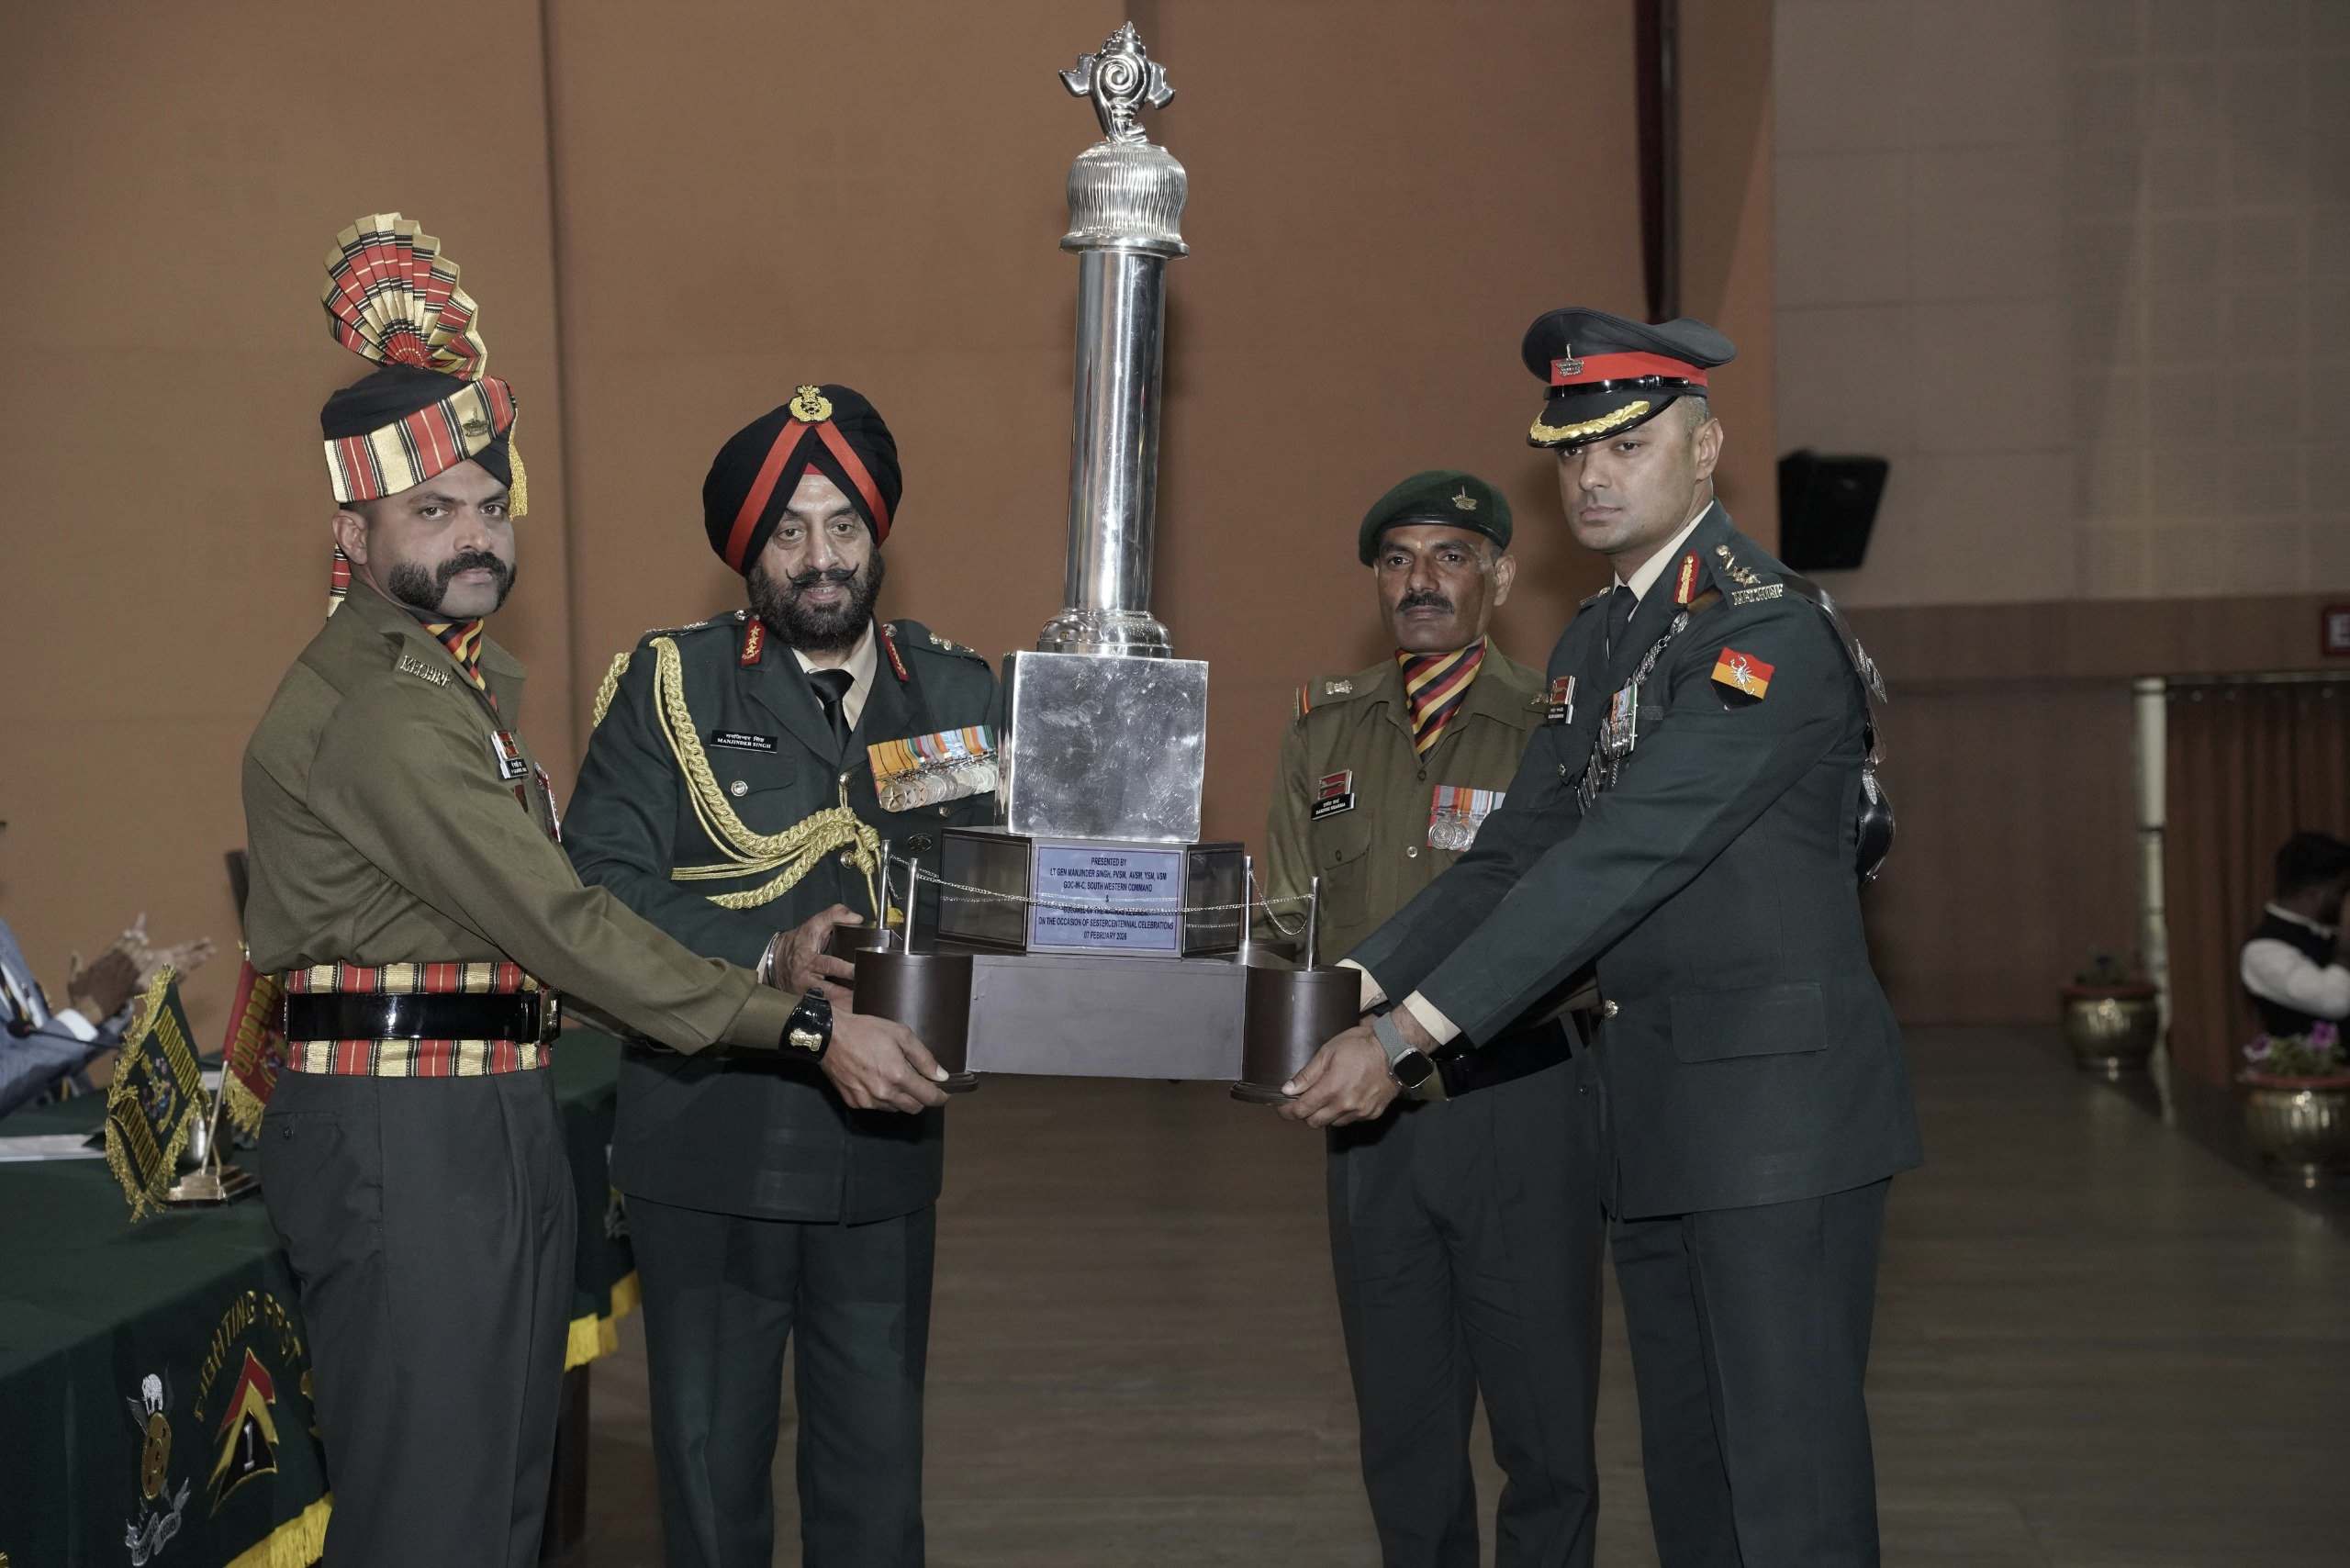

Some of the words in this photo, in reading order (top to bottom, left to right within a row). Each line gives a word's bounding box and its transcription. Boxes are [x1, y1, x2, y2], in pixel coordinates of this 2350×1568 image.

[717, 737, 752, 746] MANJINDER
[1091, 857, 1120, 867] PRESENTED
[1120, 858, 1127, 867] BY
[1050, 868, 1057, 876] LT
[1057, 868, 1068, 877] GEN
[1068, 868, 1095, 878] MANJINDER
[1157, 872, 1168, 880] VSM
[1087, 881, 1103, 890] SOUTH
[1103, 882, 1127, 891] WESTERN
[1127, 883, 1153, 892] COMMAND
[1038, 916, 1046, 925] ON
[1046, 917, 1057, 925] THE
[1057, 917, 1081, 926] OCCASION
[1082, 918, 1090, 926] OF
[1090, 918, 1137, 929] SESTERCENTENNIAL
[1138, 921, 1174, 930] CELEBRATIONS
[1091, 931, 1115, 940] FEBRUARY
